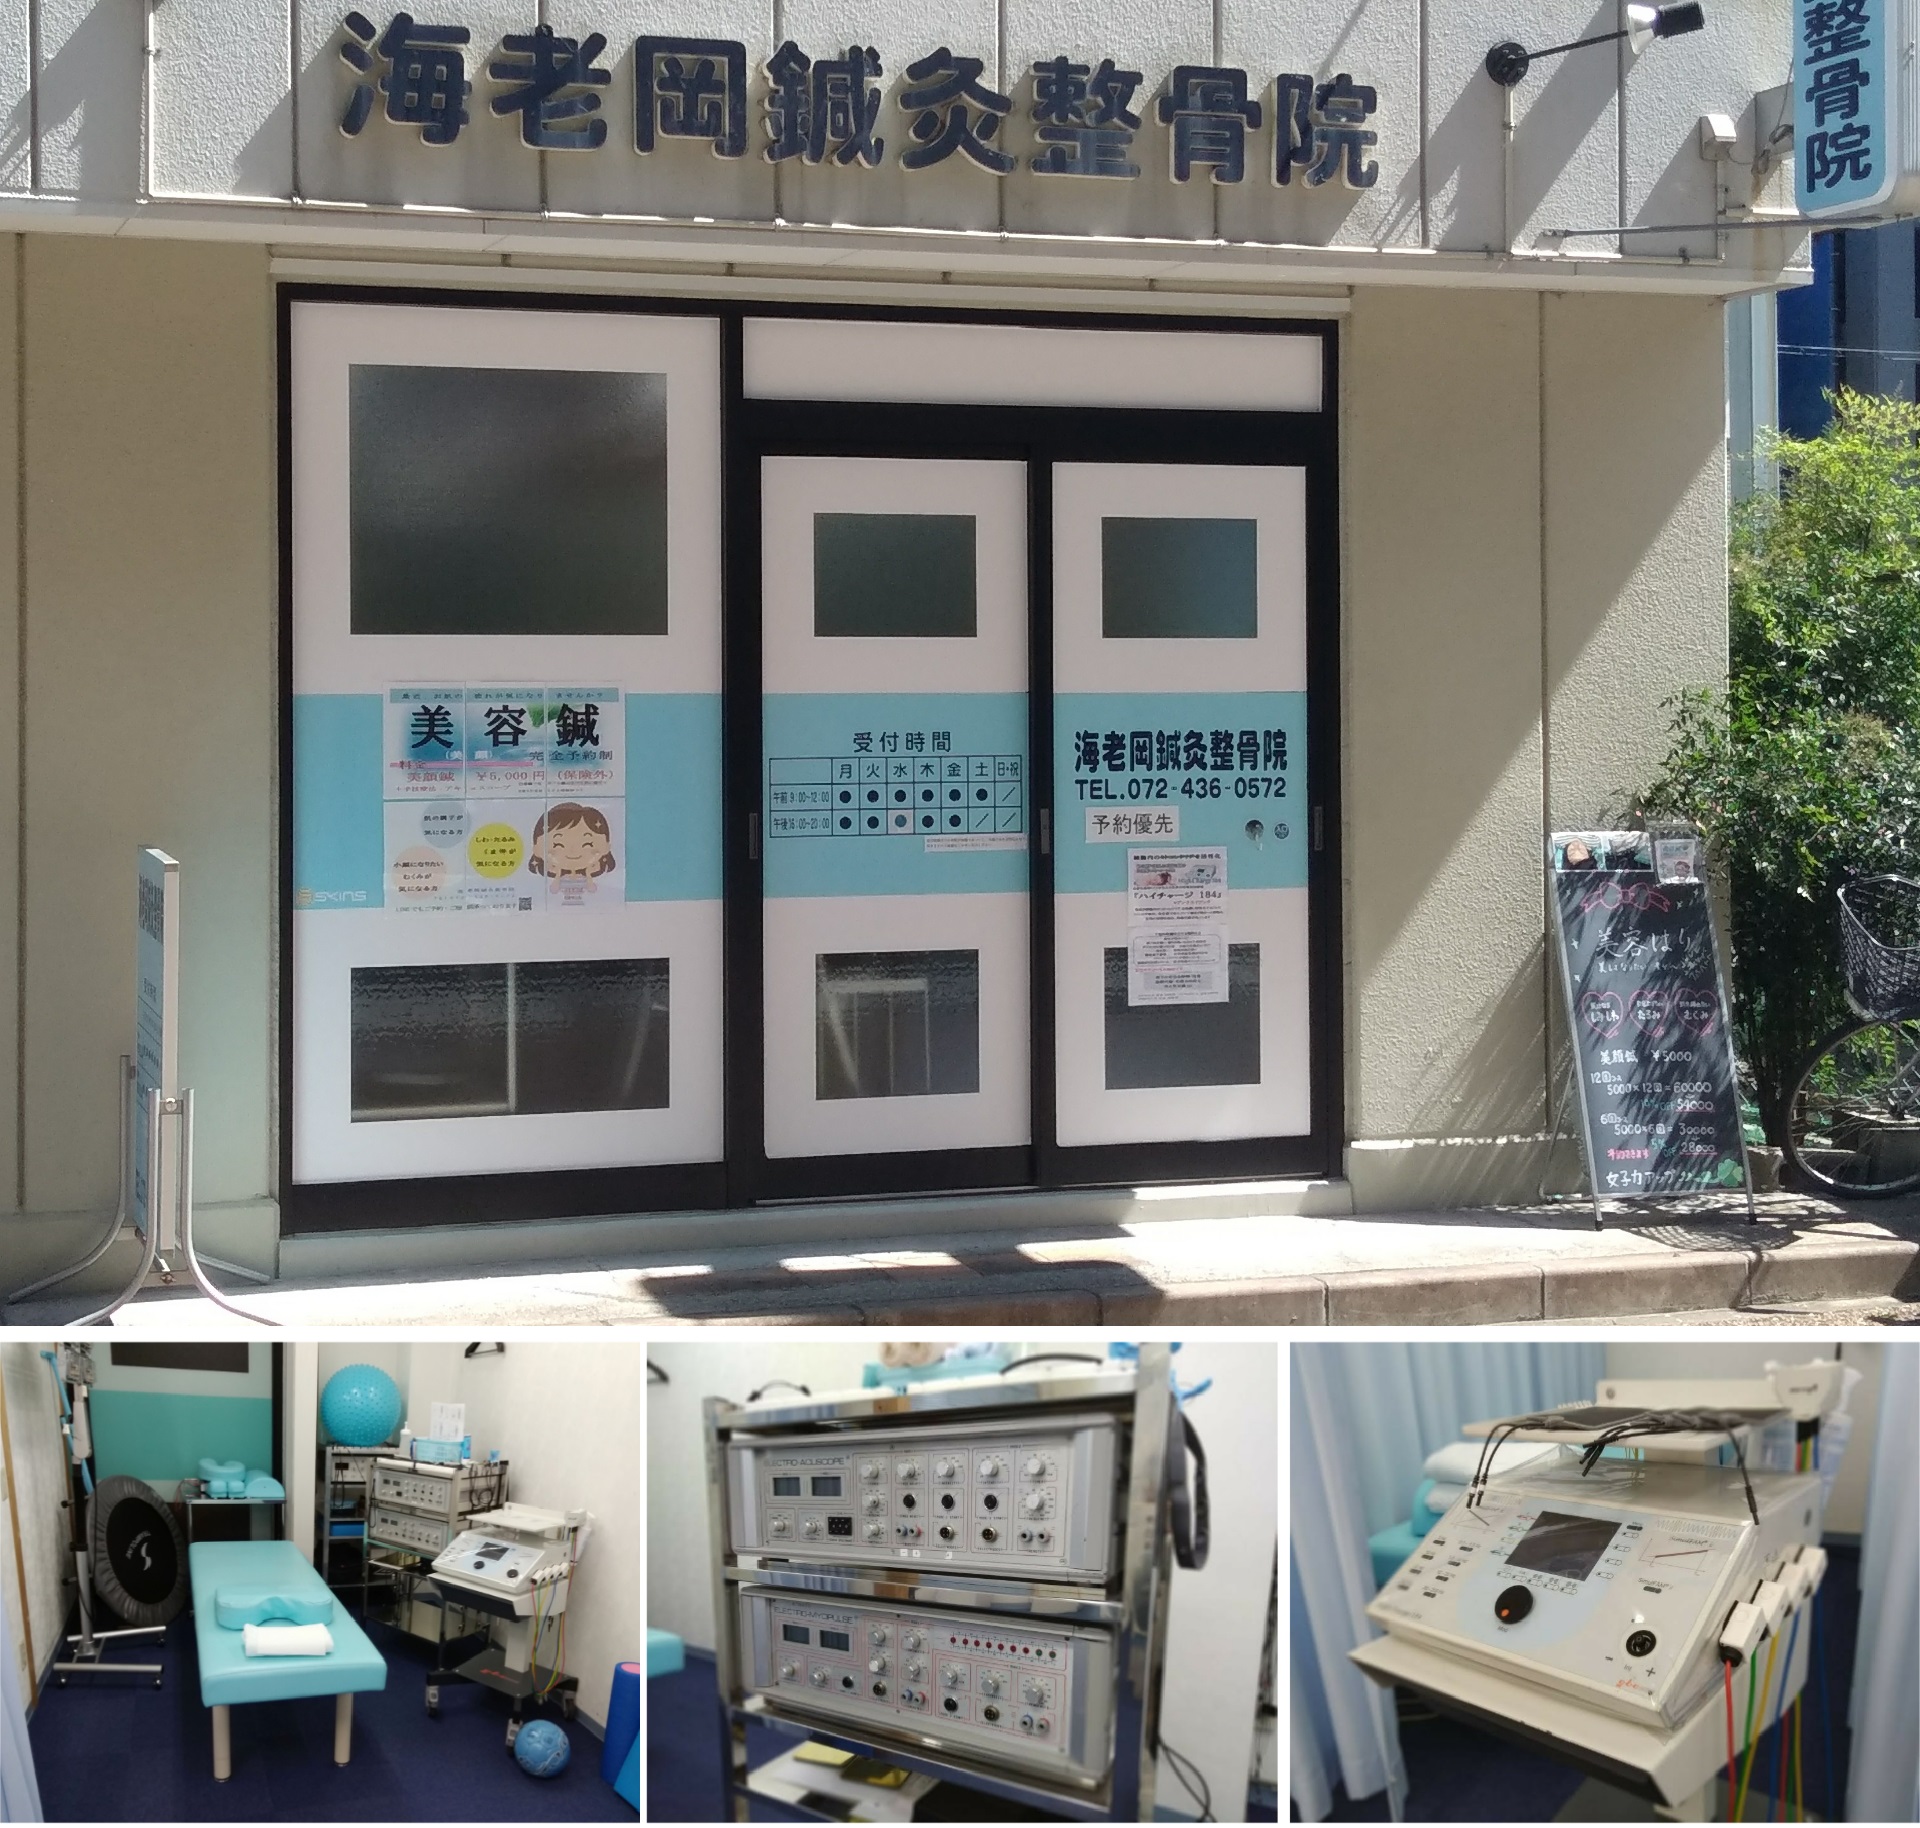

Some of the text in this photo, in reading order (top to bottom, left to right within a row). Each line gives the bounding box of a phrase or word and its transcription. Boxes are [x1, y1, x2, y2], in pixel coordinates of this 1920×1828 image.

[339, 10, 1380, 190] 海老岡鍼灸整骨院
[1803, 0, 1872, 193] 整骨院
[410, 703, 600, 749] 美容鍼
[852, 731, 952, 753] 受付時間
[839, 763, 852, 779] 月
[866, 763, 880, 778] 火
[892, 763, 908, 778] 水
[920, 762, 935, 777] 木
[946, 762, 962, 777] 金
[974, 762, 989, 777] 土
[1074, 728, 1289, 774] 海老岡鍼灸整骨院
[1091, 812, 1174, 835] 予約優先
[1596, 926, 1692, 958] 美容はり
